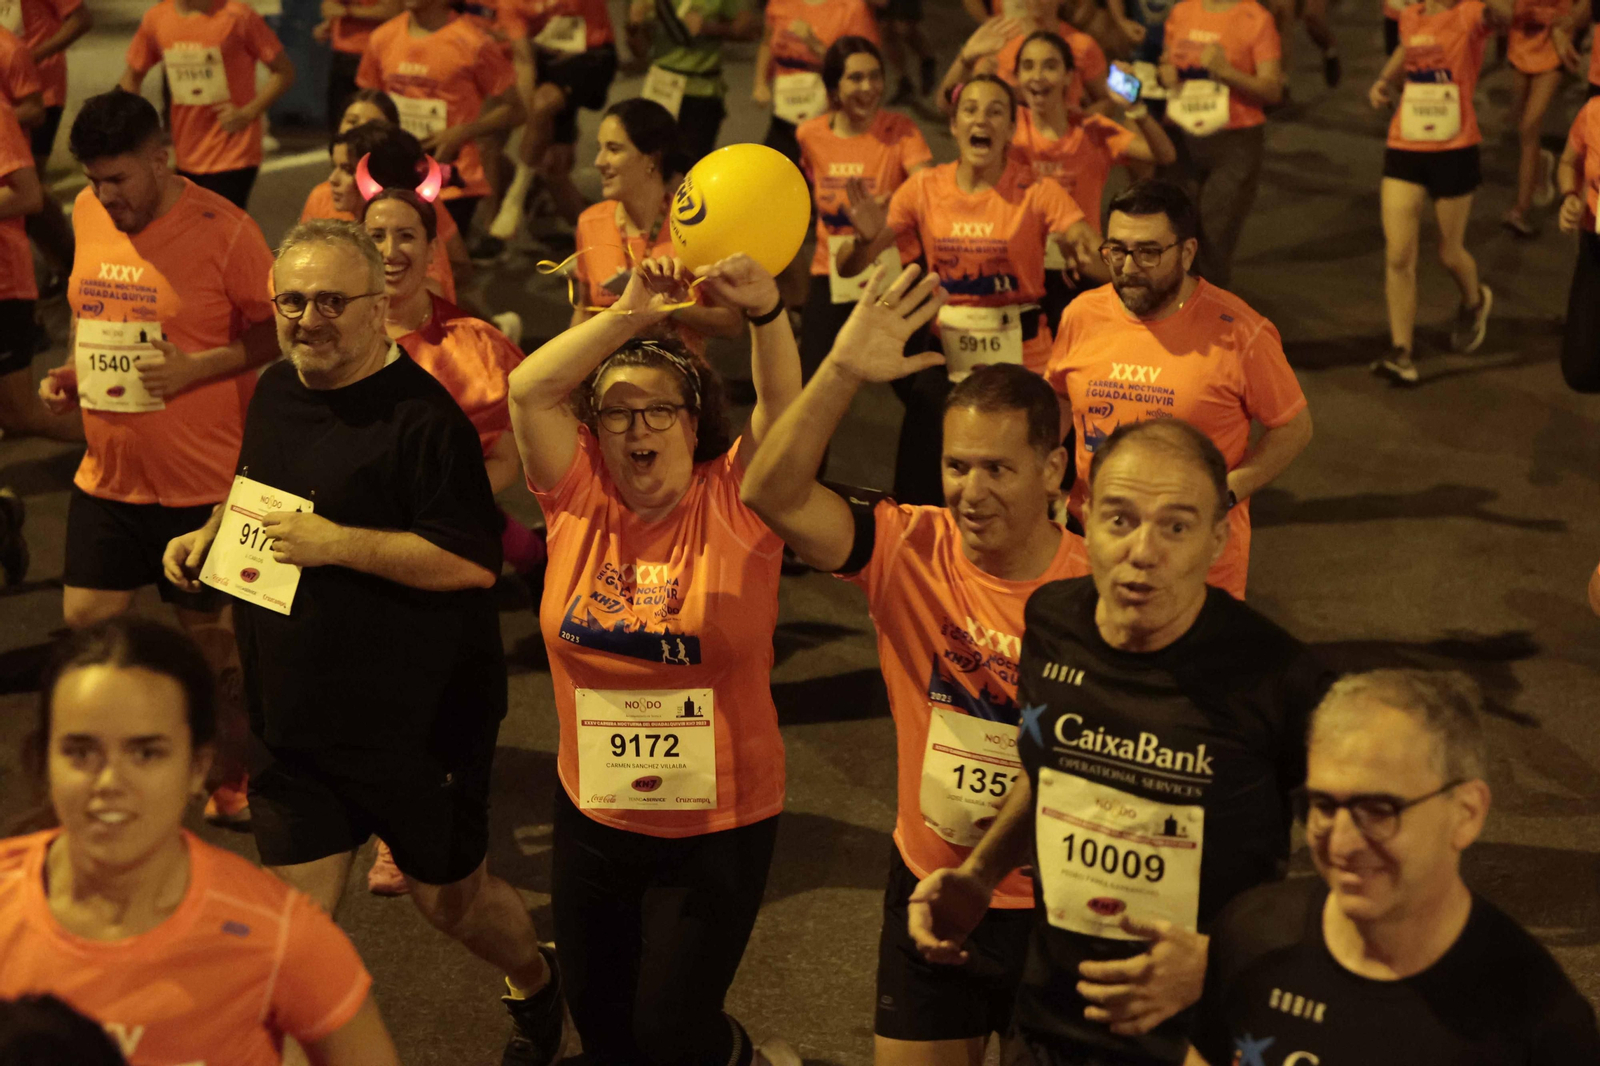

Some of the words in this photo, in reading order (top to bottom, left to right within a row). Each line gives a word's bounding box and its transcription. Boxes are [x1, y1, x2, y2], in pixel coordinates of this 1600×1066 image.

[951, 221, 994, 238] XXXV
[98, 262, 144, 283] XXXV
[80, 279, 111, 288] CARRERA
[115, 282, 157, 294] NOCTURNA
[83, 287, 157, 304] GUADALQUIVIR
[960, 335, 1001, 351] 5916
[89, 353, 141, 373] 1540
[1109, 362, 1162, 384] XXXV
[1088, 380, 1125, 390] CARRERA
[1128, 383, 1175, 396] NOCTURNA
[1091, 388, 1174, 407] GUADALQUIVIR
[610, 733, 680, 758] 9172
[1054, 713, 1216, 776] CaixaBank
[953, 764, 1019, 798] 135
[1059, 756, 1138, 784] OPERATIONAL
[1141, 777, 1203, 798] SERVICES
[675, 796, 710, 805] Cruzcampo
[1062, 833, 1165, 883] 10009
